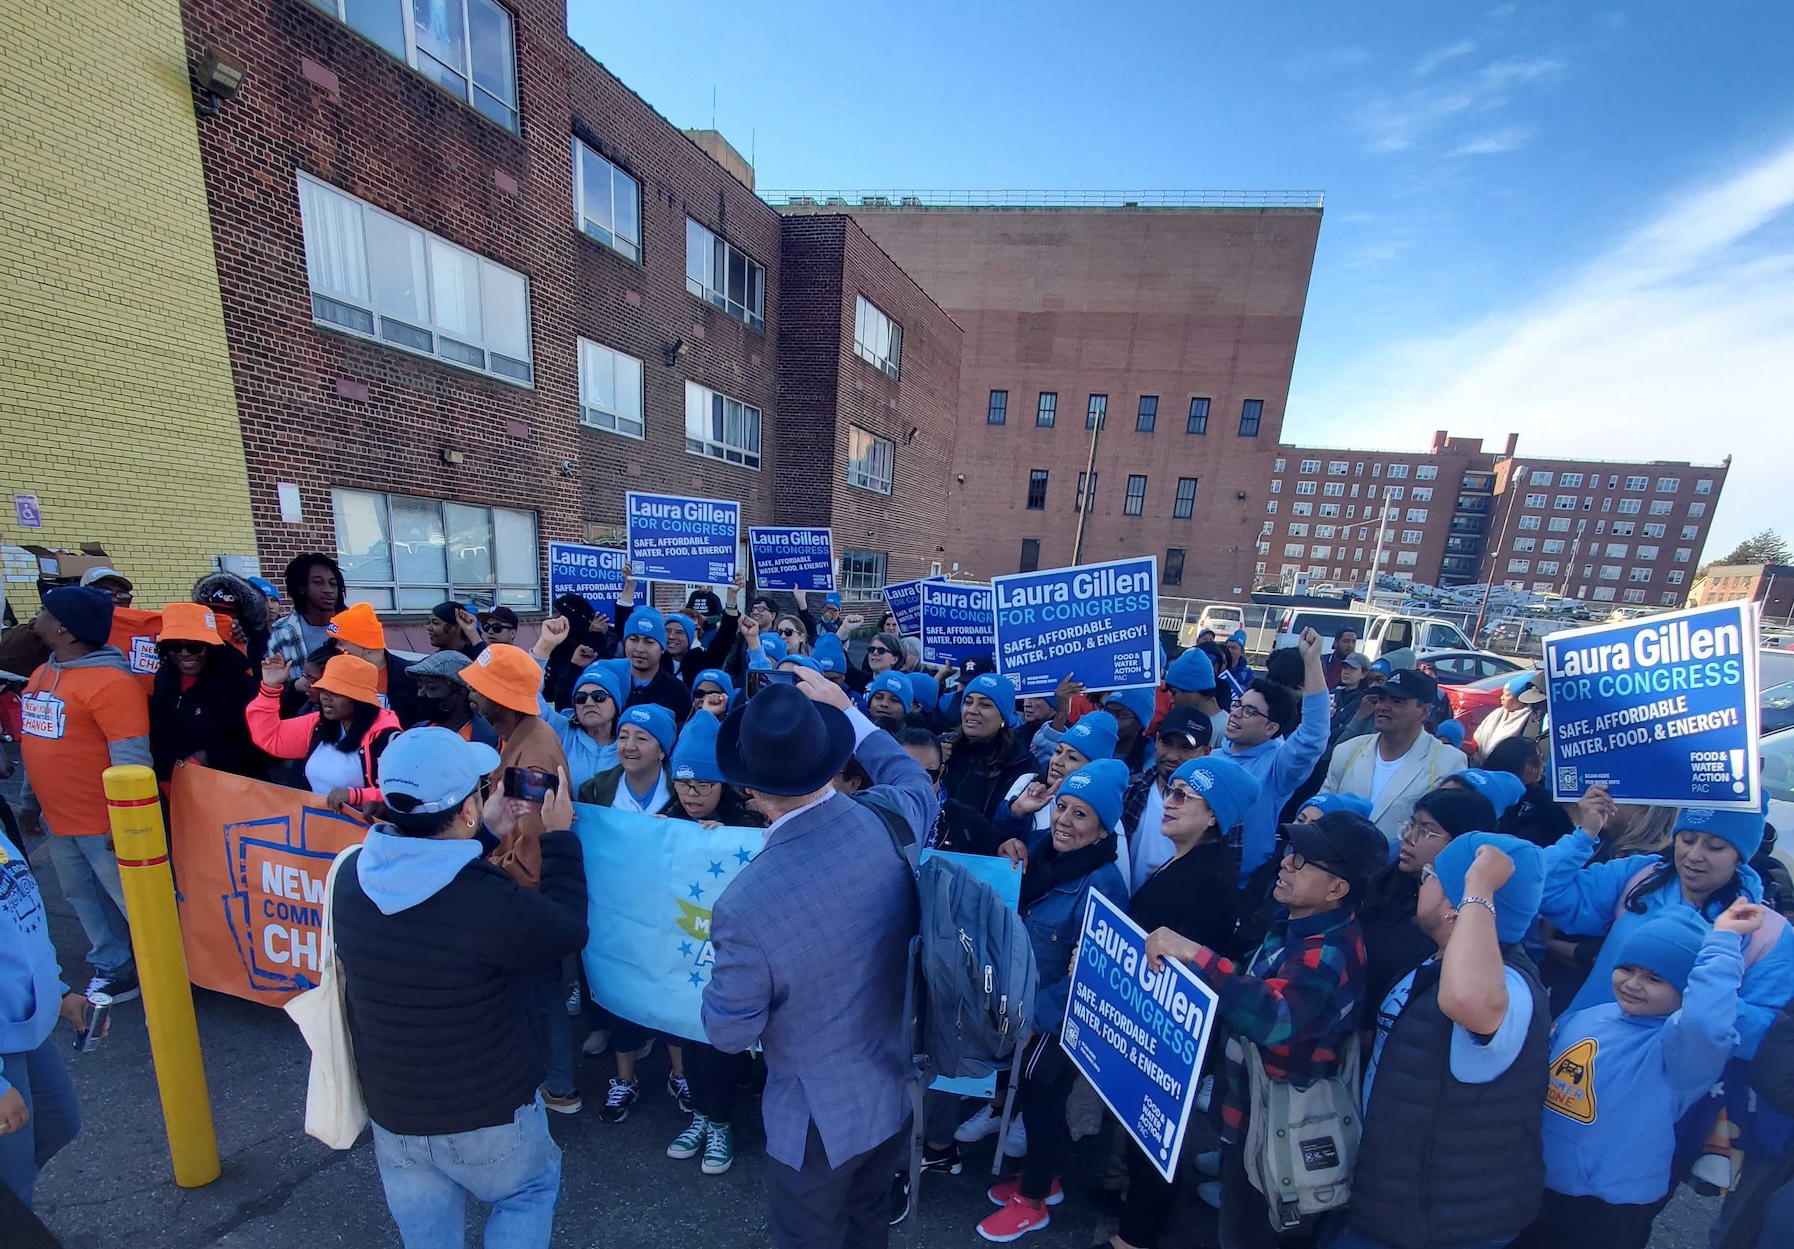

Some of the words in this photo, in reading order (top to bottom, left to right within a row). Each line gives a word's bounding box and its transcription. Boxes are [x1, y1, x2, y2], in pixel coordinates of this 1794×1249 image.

[631, 497, 682, 519] Laura
[684, 502, 736, 524] Gillen
[631, 517, 657, 529] FOR
[662, 519, 735, 537] CONGRESS
[634, 538, 658, 547] SAFE,
[658, 536, 710, 546] AFFORDABLE
[752, 531, 790, 545] Laura
[790, 531, 829, 546] Gillen
[552, 547, 595, 568] Laura
[600, 552, 626, 570] Gill
[634, 548, 664, 557] WATER,
[665, 547, 690, 556] FOOD,
[691, 547, 697, 555] &
[699, 545, 733, 554] ENERGY!
[754, 545, 773, 553] FOR
[775, 546, 829, 555] CONGRESS
[774, 555, 812, 565] AFFORDABLE
[552, 564, 576, 576] FOR
[580, 567, 623, 580] CONGR
[555, 584, 576, 593] SAFE,
[576, 583, 623, 592] AFFORDABLE
[583, 592, 606, 601] FOOD,
[885, 586, 915, 600] Laura
[924, 586, 967, 608] Laura
[997, 581, 1069, 609] Laura
[1073, 569, 1150, 599] Gillen
[924, 605, 946, 618] FOR
[950, 608, 993, 624] CONGR
[999, 608, 1035, 627] FOR
[1042, 594, 1150, 621] CONGRESS
[926, 626, 946, 635] SAFE,
[947, 625, 993, 635] AFFORDABLE
[1003, 638, 1036, 655] SAFE,
[1038, 618, 1113, 646] AFFORDABLE
[926, 636, 952, 645] WATER,
[953, 636, 975, 645] FOOD,
[976, 636, 982, 644] &
[1005, 649, 1048, 668] WATER,
[1049, 640, 1085, 658] FOOD,
[1086, 637, 1095, 649] &
[1097, 624, 1148, 647] ENERGY!
[1549, 642, 1630, 679] Laura
[1634, 620, 1740, 667] Gillen
[1113, 653, 1134, 661] FOOD
[1114, 659, 1138, 667] WATER
[1114, 666, 1141, 674] ACTION
[1552, 678, 1592, 702] FOR
[1599, 660, 1740, 697] CONGRESS
[1558, 719, 1595, 740] SAFE,
[1596, 695, 1688, 730] AFFORDABLE
[1560, 737, 1607, 759] WATER,
[1609, 727, 1652, 749] FOOD,
[1654, 723, 1667, 740] &
[1667, 707, 1738, 738] ENERGY!
[1690, 752, 1719, 762] FOOD
[1719, 752, 1727, 761] &
[1691, 762, 1725, 772] WATER
[1692, 773, 1730, 783] ACTION
[1692, 783, 1710, 793] PAC
[1086, 901, 1138, 977] Laura
[1139, 954, 1204, 1041] Gillen
[1081, 937, 1107, 978] FOR
[1110, 967, 1195, 1065] CONGRESS
[1076, 981, 1098, 1011] SAFE,
[1099, 999, 1157, 1056] AFFORDABLE
[1073, 999, 1101, 1036] WATER,
[1102, 1023, 1129, 1059] FOOD,
[1129, 1047, 1138, 1065] &
[1138, 1053, 1182, 1100] ENERGY!
[1548, 1089, 1575, 1107] ONE
[1142, 1103, 1162, 1131] WATER
[1144, 1094, 1160, 1119] FOOD
[1160, 1113, 1166, 1124] &
[1137, 1123, 1149, 1139] PAC
[1139, 1114, 1163, 1143] ACTION
